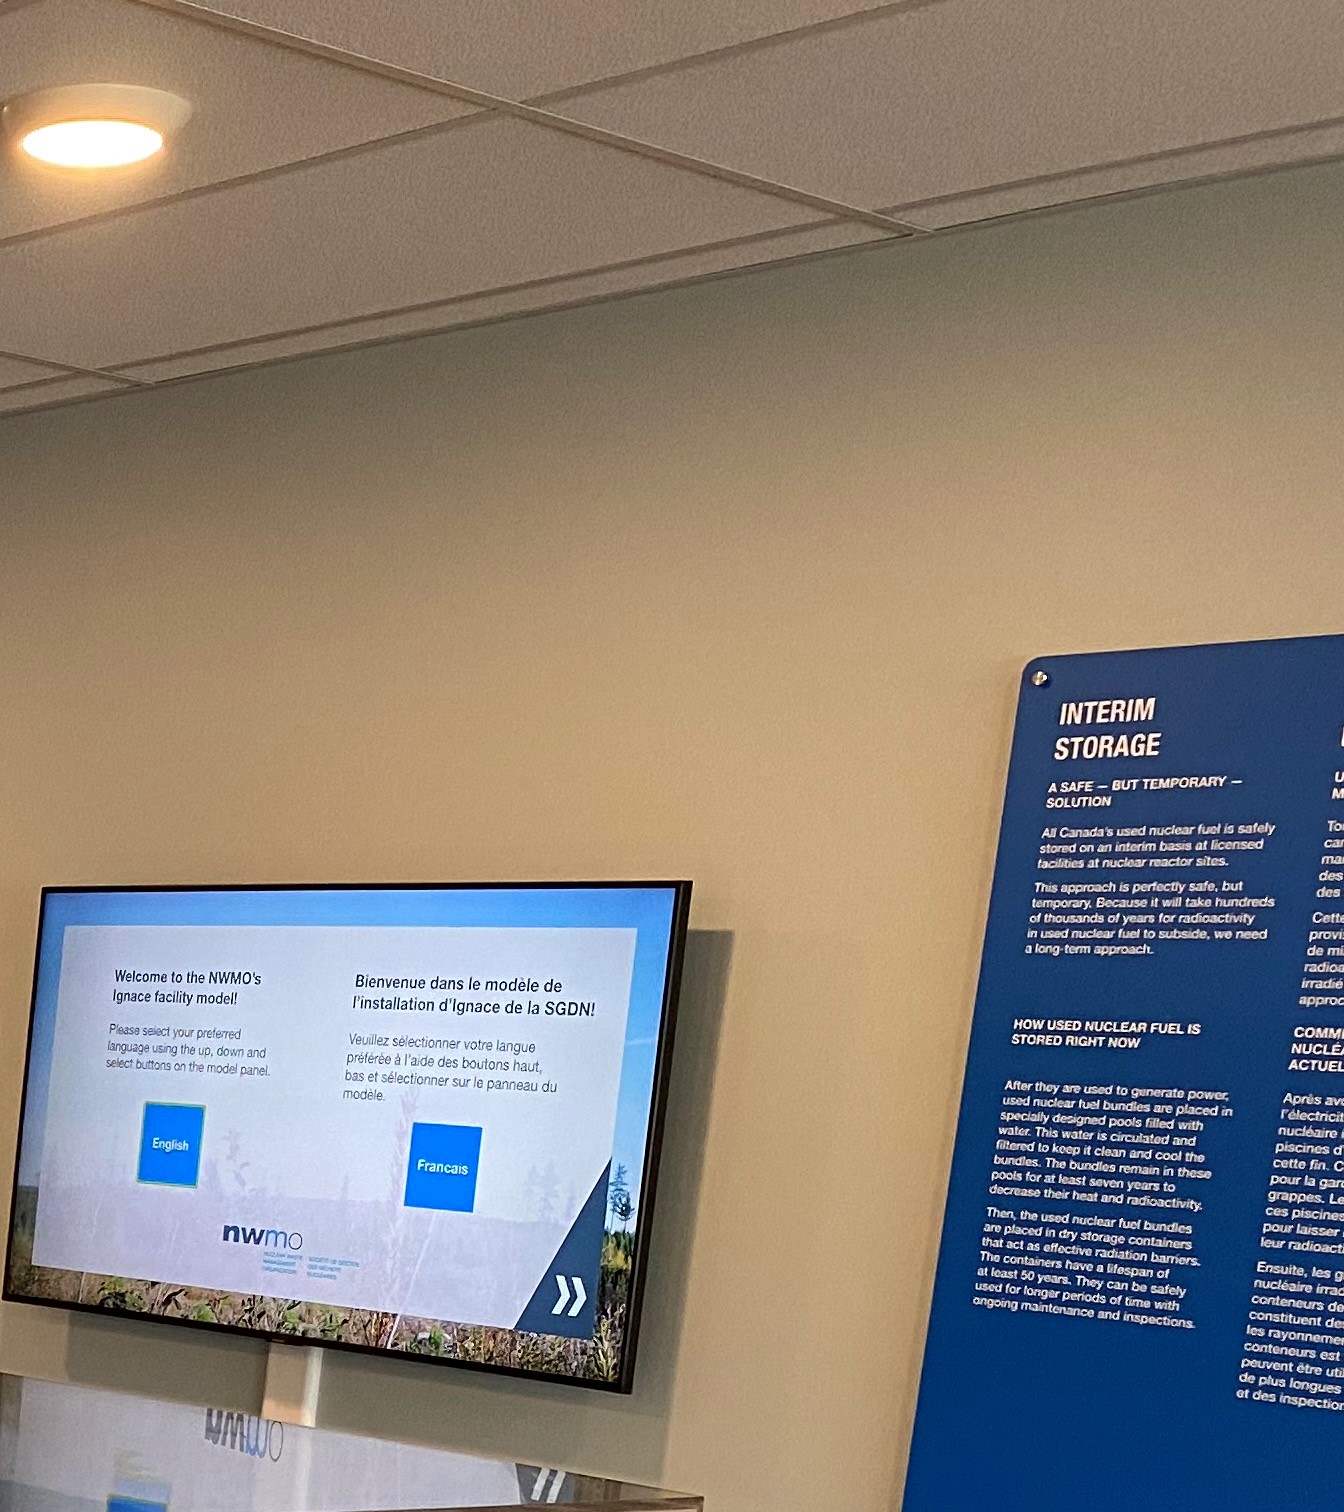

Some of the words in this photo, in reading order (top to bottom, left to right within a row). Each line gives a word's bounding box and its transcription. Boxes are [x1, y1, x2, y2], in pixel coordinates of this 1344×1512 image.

[1060, 697, 1156, 725] INTERIM
[1054, 733, 1161, 760] STORAGE
[1048, 783, 1057, 793] A
[1060, 781, 1094, 792] SAFE
[1112, 779, 1140, 791] BUT
[1142, 776, 1227, 790] TEMPORARY
[1046, 796, 1112, 808] SOLUTION
[115, 969, 167, 983] Welcome
[171, 971, 182, 983] to
[187, 971, 205, 983] the
[356, 974, 425, 989] Bienvenue
[431, 976, 464, 990] dans
[469, 977, 480, 990] le
[485, 978, 539, 992] modèle
[544, 979, 562, 992] de
[113, 989, 151, 1004] Ignace
[155, 990, 193, 1006] facility
[197, 992, 237, 1005] model!
[505, 1000, 522, 1014] de
[527, 1000, 539, 1014] la
[545, 1001, 595, 1016] SGDN!
[108, 1023, 140, 1038] Please
[143, 1027, 170, 1037] select
[173, 1029, 194, 1040] your
[197, 1028, 241, 1040] preferred
[1014, 1019, 1045, 1030] HOW
[1047, 1020, 1082, 1031] USED
[1085, 1021, 1147, 1033] NUCLEAR
[1150, 1023, 1184, 1034] FUEL
[1187, 1024, 1201, 1034] IS
[107, 1041, 149, 1055] language
[152, 1045, 177, 1057] using
[181, 1044, 195, 1055] the
[199, 1047, 213, 1058] up,
[217, 1046, 244, 1057] down
[247, 1048, 266, 1058] and
[1011, 1034, 1062, 1046] STORED
[1065, 1035, 1106, 1047] RIGHT
[1108, 1037, 1141, 1048] NOW
[106, 1057, 133, 1068] select
[136, 1058, 171, 1071] buttons
[174, 1063, 186, 1071] on
[189, 1061, 204, 1072] the
[207, 1063, 237, 1074] model
[240, 1065, 270, 1077] panel.
[153, 1137, 189, 1152] English
[417, 1159, 468, 1175] Francais
[223, 1225, 302, 1250] nwmo
